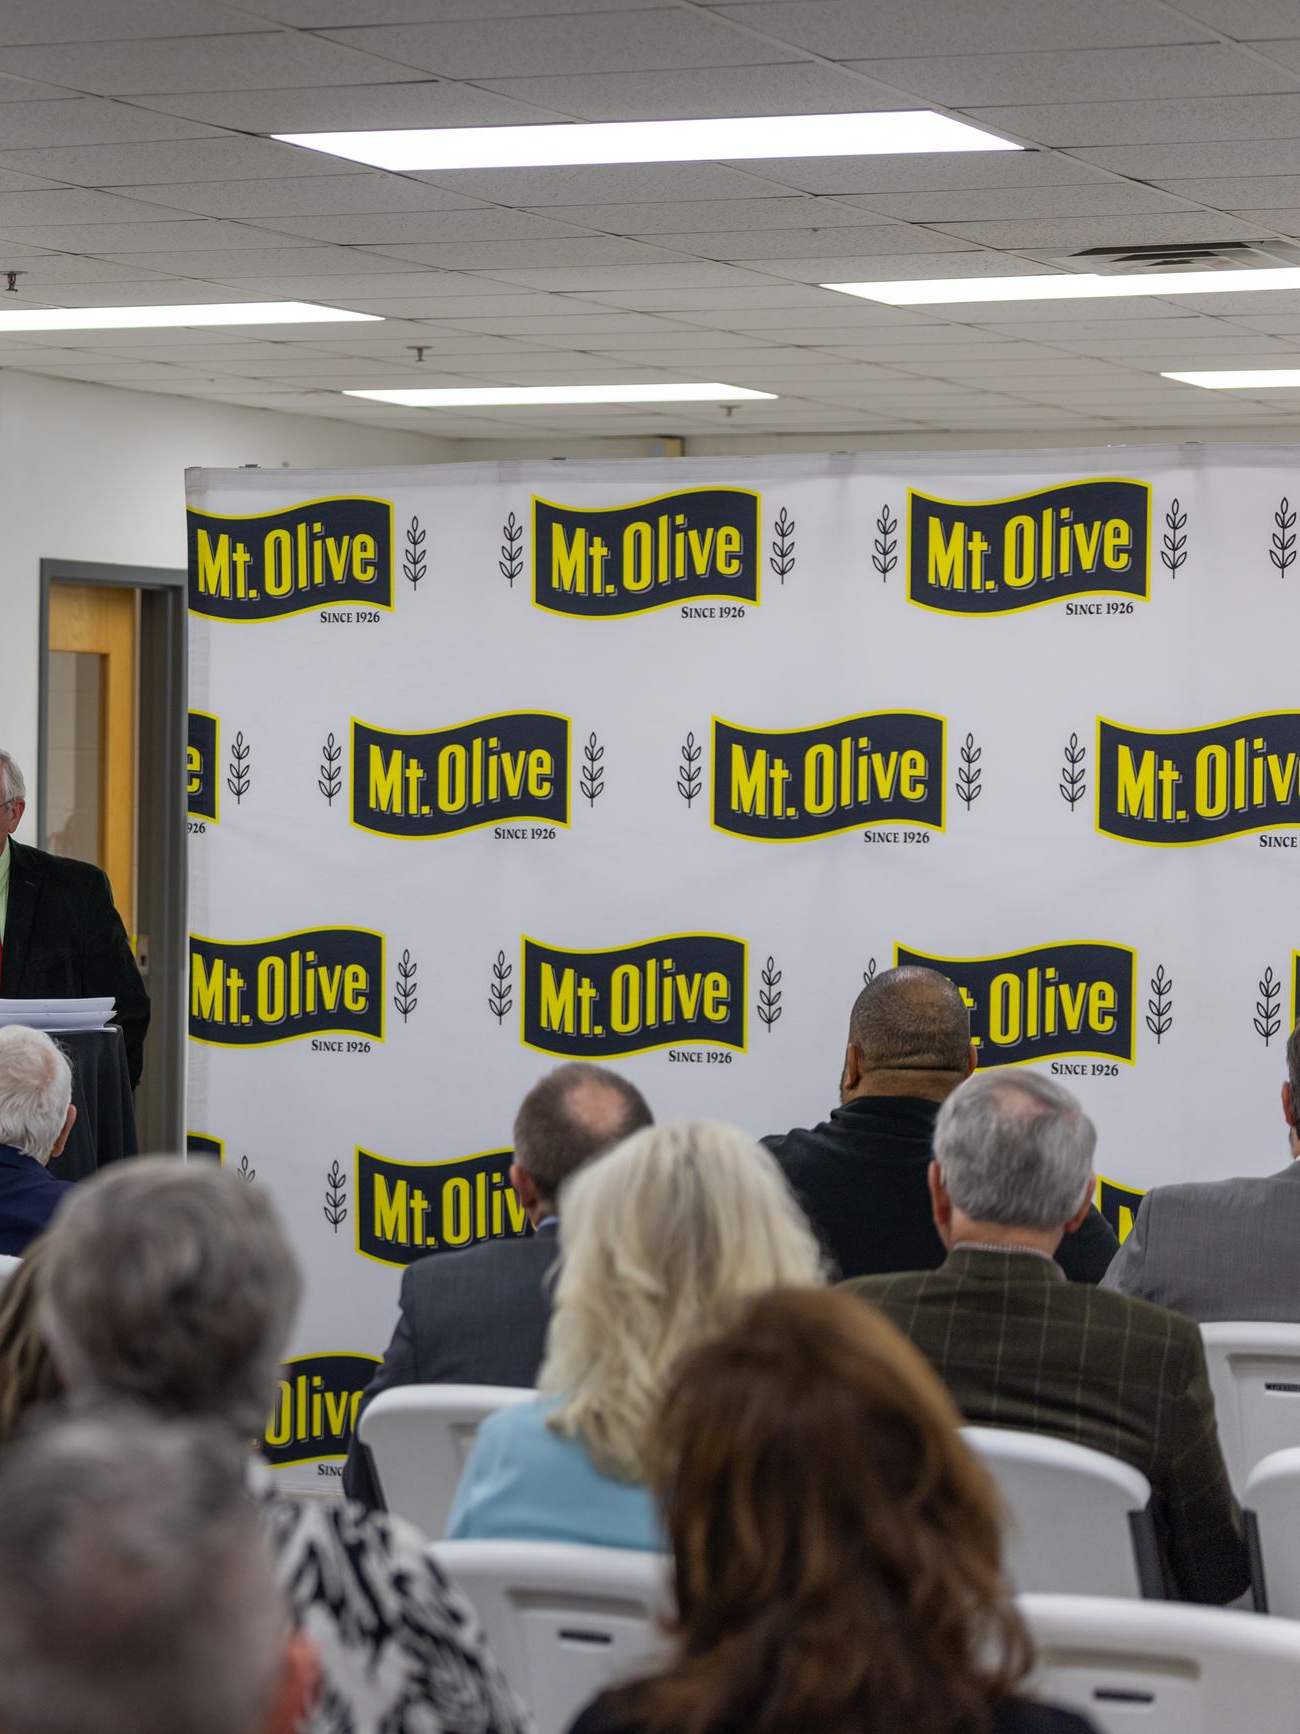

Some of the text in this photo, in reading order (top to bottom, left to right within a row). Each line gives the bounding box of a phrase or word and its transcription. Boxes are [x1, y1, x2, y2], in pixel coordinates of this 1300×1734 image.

[197, 522, 376, 599] Mt. Olive
[551, 514, 742, 595] Mt. Olive
[927, 508, 1131, 591] Mt. Olive
[355, 612, 381, 624] 1926
[719, 607, 745, 619] 1926
[1106, 602, 1134, 615] 1926
[369, 737, 553, 815] Mt. Olive
[731, 736, 927, 818] Mt. Olive
[1117, 737, 1300, 820] Mt. Oliv
[187, 822, 206, 833] 926
[531, 828, 556, 839] 1926
[903, 831, 930, 843] 1926
[191, 951, 368, 1025] Mt. Olive
[540, 959, 729, 1036] Mt. Olive
[989, 967, 1116, 1045] Olive
[346, 1041, 371, 1053] 1926
[706, 1051, 733, 1063] 1926
[1091, 1063, 1119, 1076] 1926
[374, 1172, 536, 1247] Mt. Oliv
[317, 1464, 344, 1477] SINC
